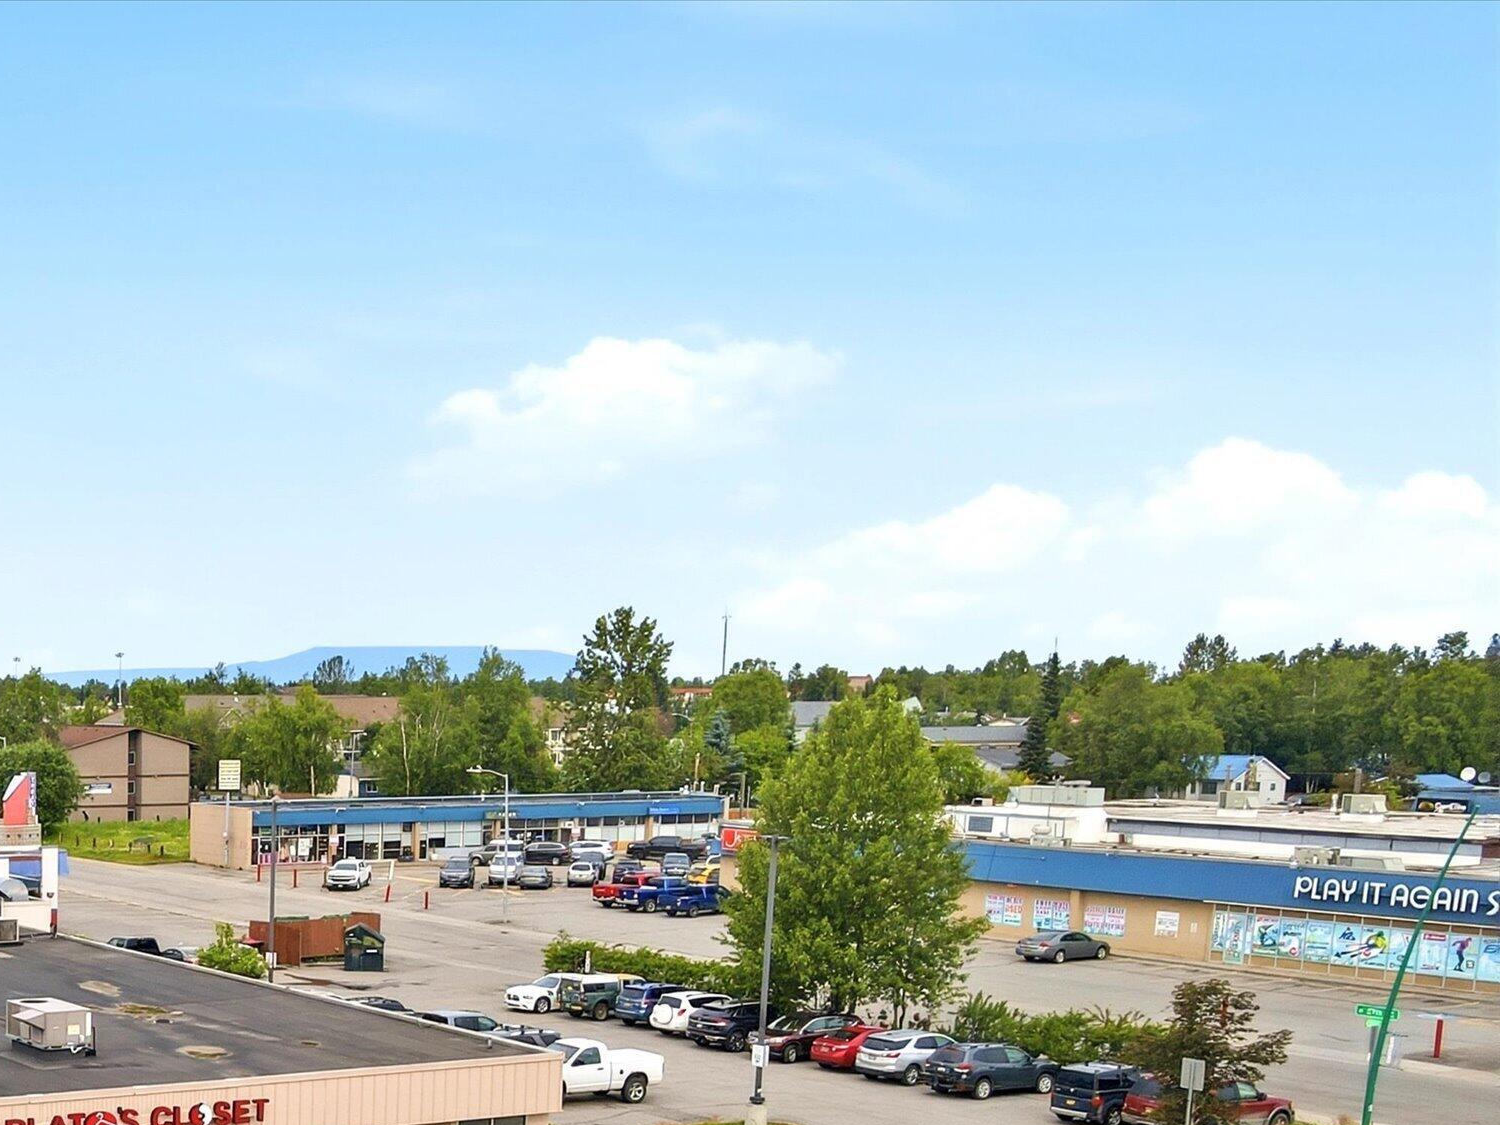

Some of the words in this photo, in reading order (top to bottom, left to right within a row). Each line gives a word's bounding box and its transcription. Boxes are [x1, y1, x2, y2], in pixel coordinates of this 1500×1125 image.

[1293, 876, 1358, 902] PLAY
[1361, 881, 1387, 905] IT
[1389, 884, 1479, 914] AGAIN
